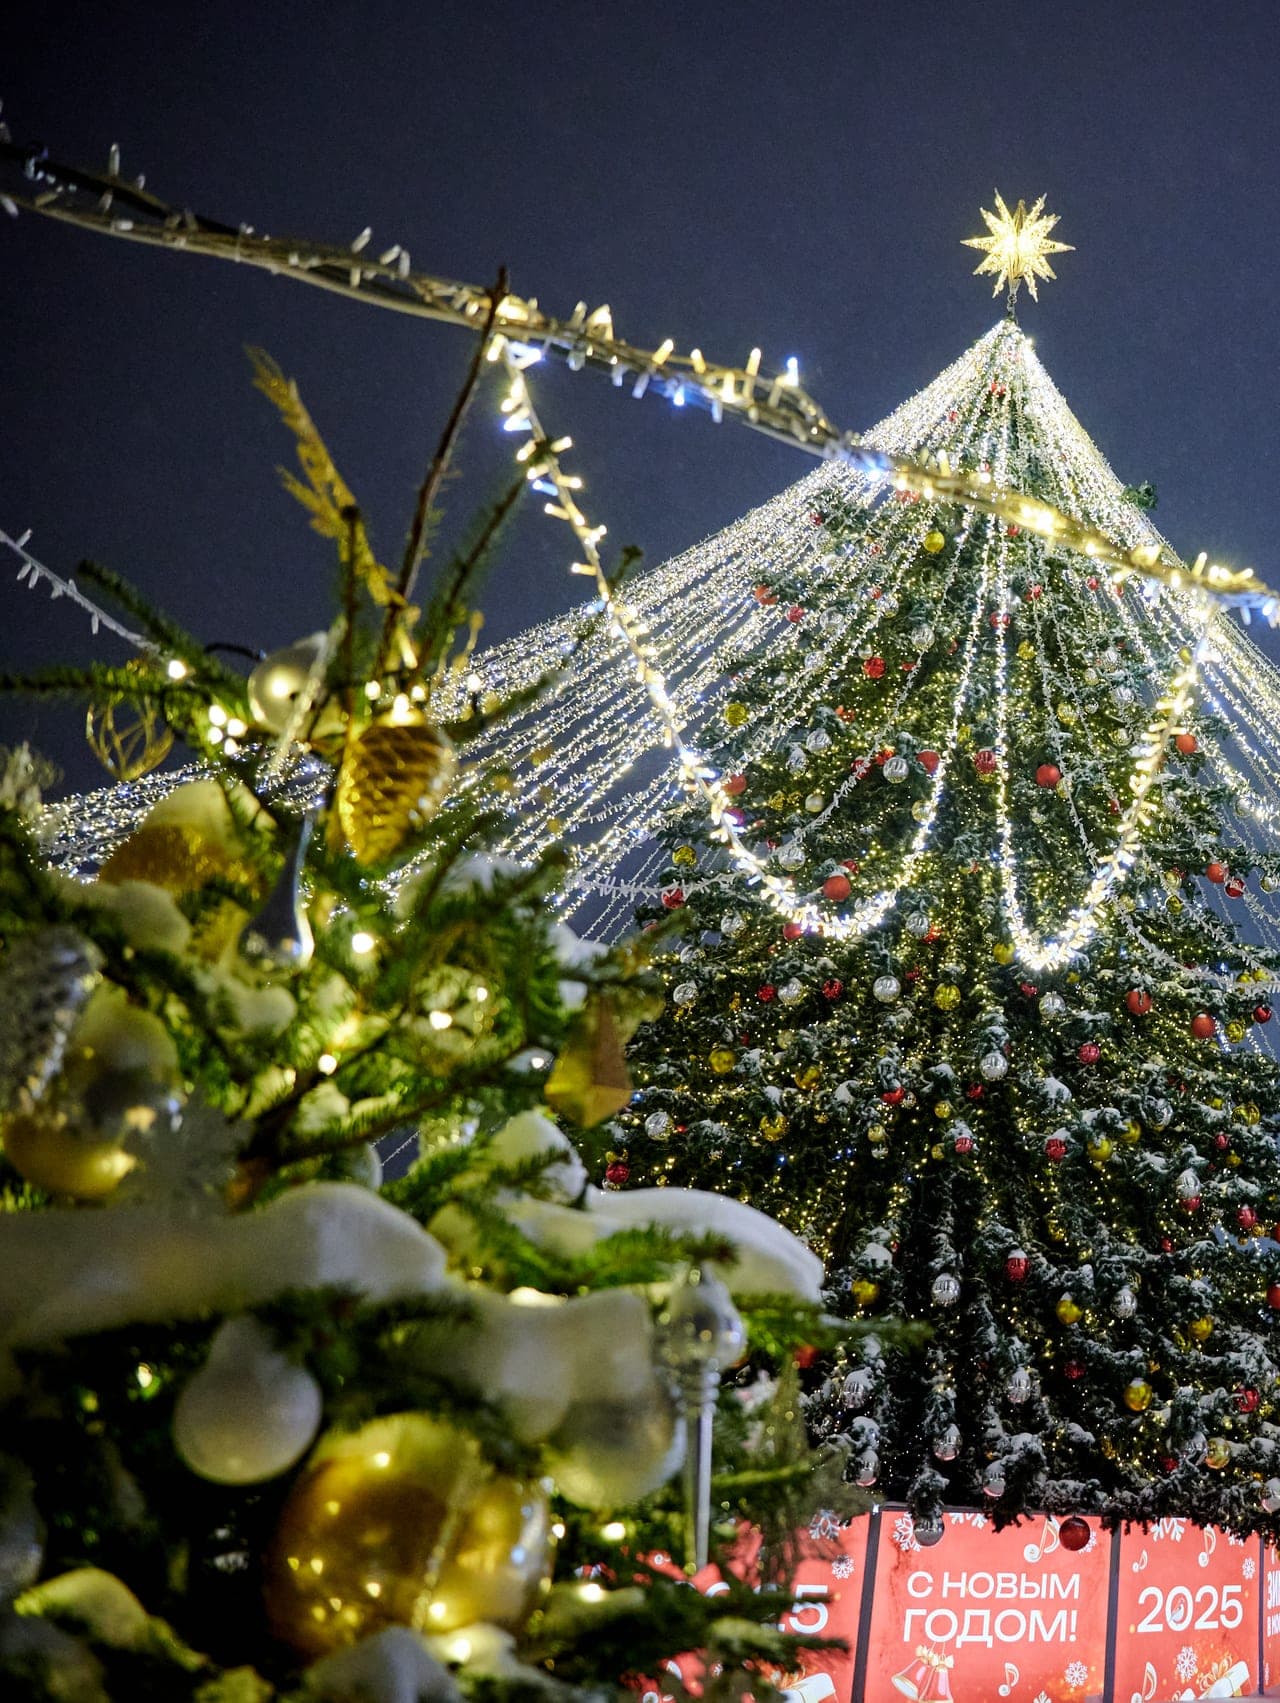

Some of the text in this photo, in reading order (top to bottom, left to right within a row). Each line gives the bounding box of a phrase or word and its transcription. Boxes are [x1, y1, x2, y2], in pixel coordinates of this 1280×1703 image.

[907, 1570, 1081, 1600] С НОВЫМ
[903, 1608, 1078, 1649] ГОДОМ!
[1136, 1584, 1243, 1632] 2025
